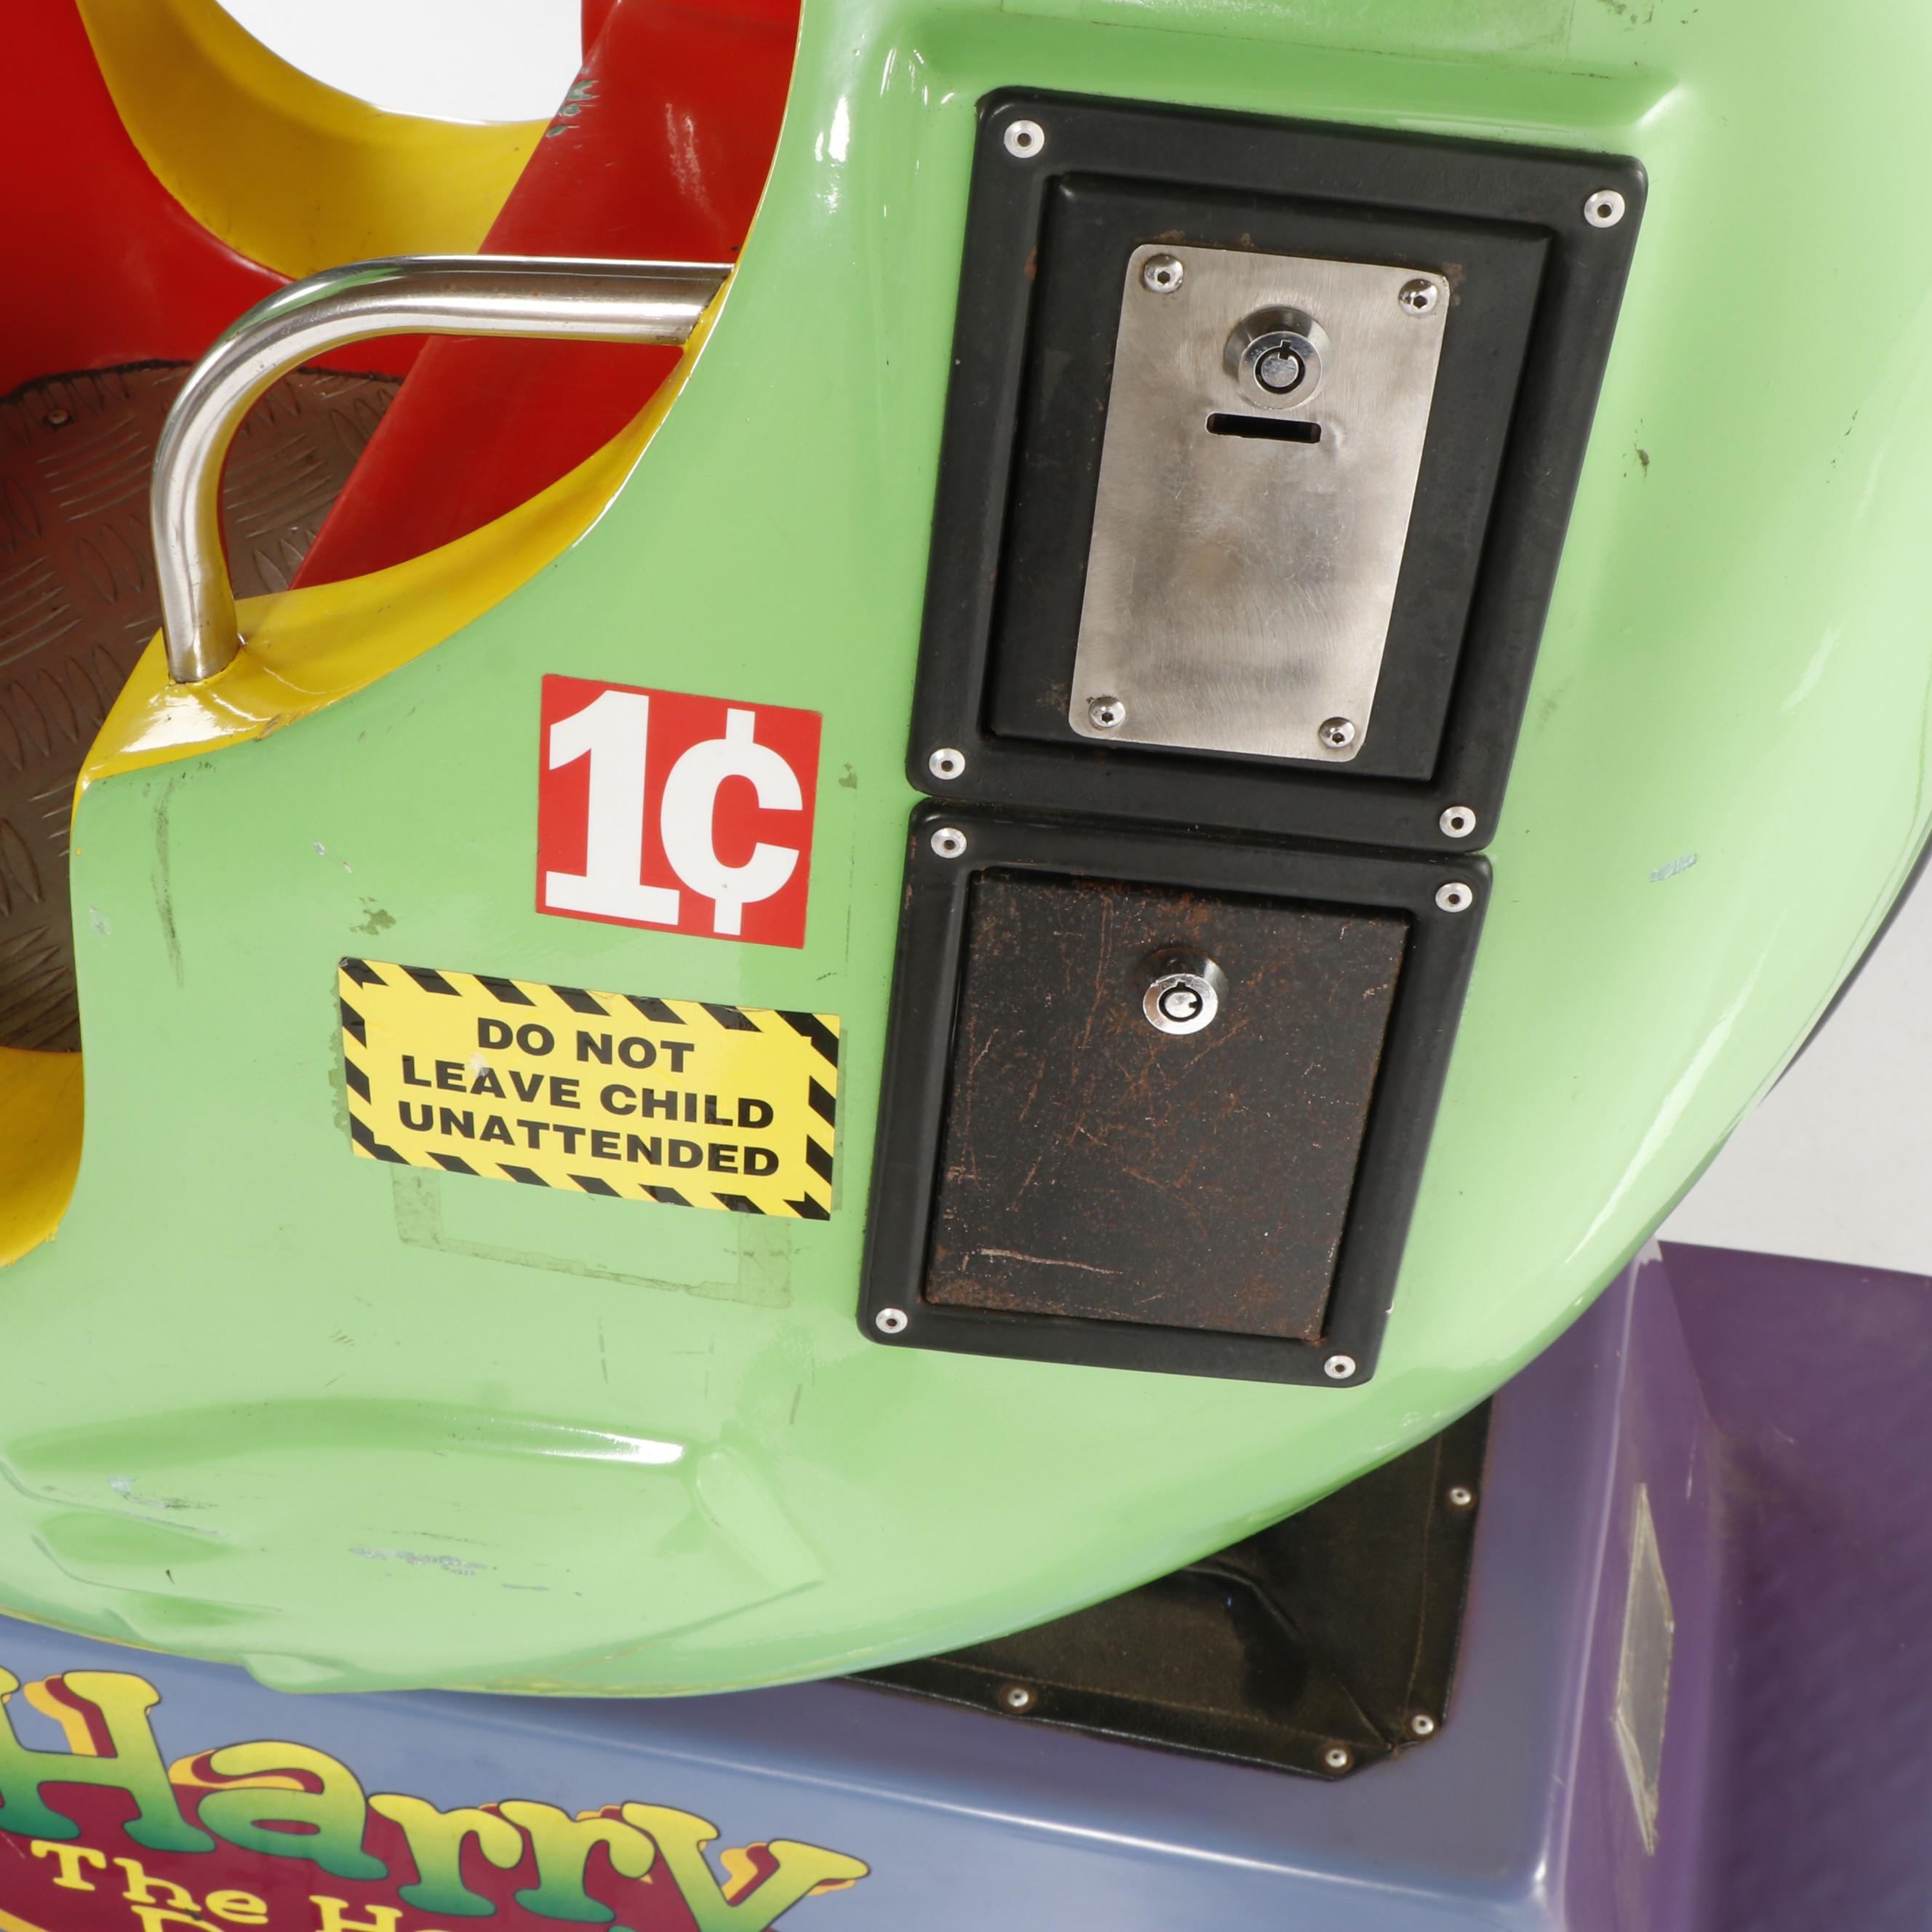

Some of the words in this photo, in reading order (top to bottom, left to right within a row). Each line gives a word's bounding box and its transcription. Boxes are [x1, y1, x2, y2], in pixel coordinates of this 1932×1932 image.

[544, 690, 804, 936] 1¢
[477, 1018, 555, 1056] DO
[575, 1031, 695, 1073] NOT
[402, 1055, 580, 1109] LEAVE
[600, 1084, 775, 1128] CHILD
[399, 1101, 780, 1177] UNATTENDED
[0, 1665, 869, 1932] Harry
[31, 1839, 268, 1924] The
